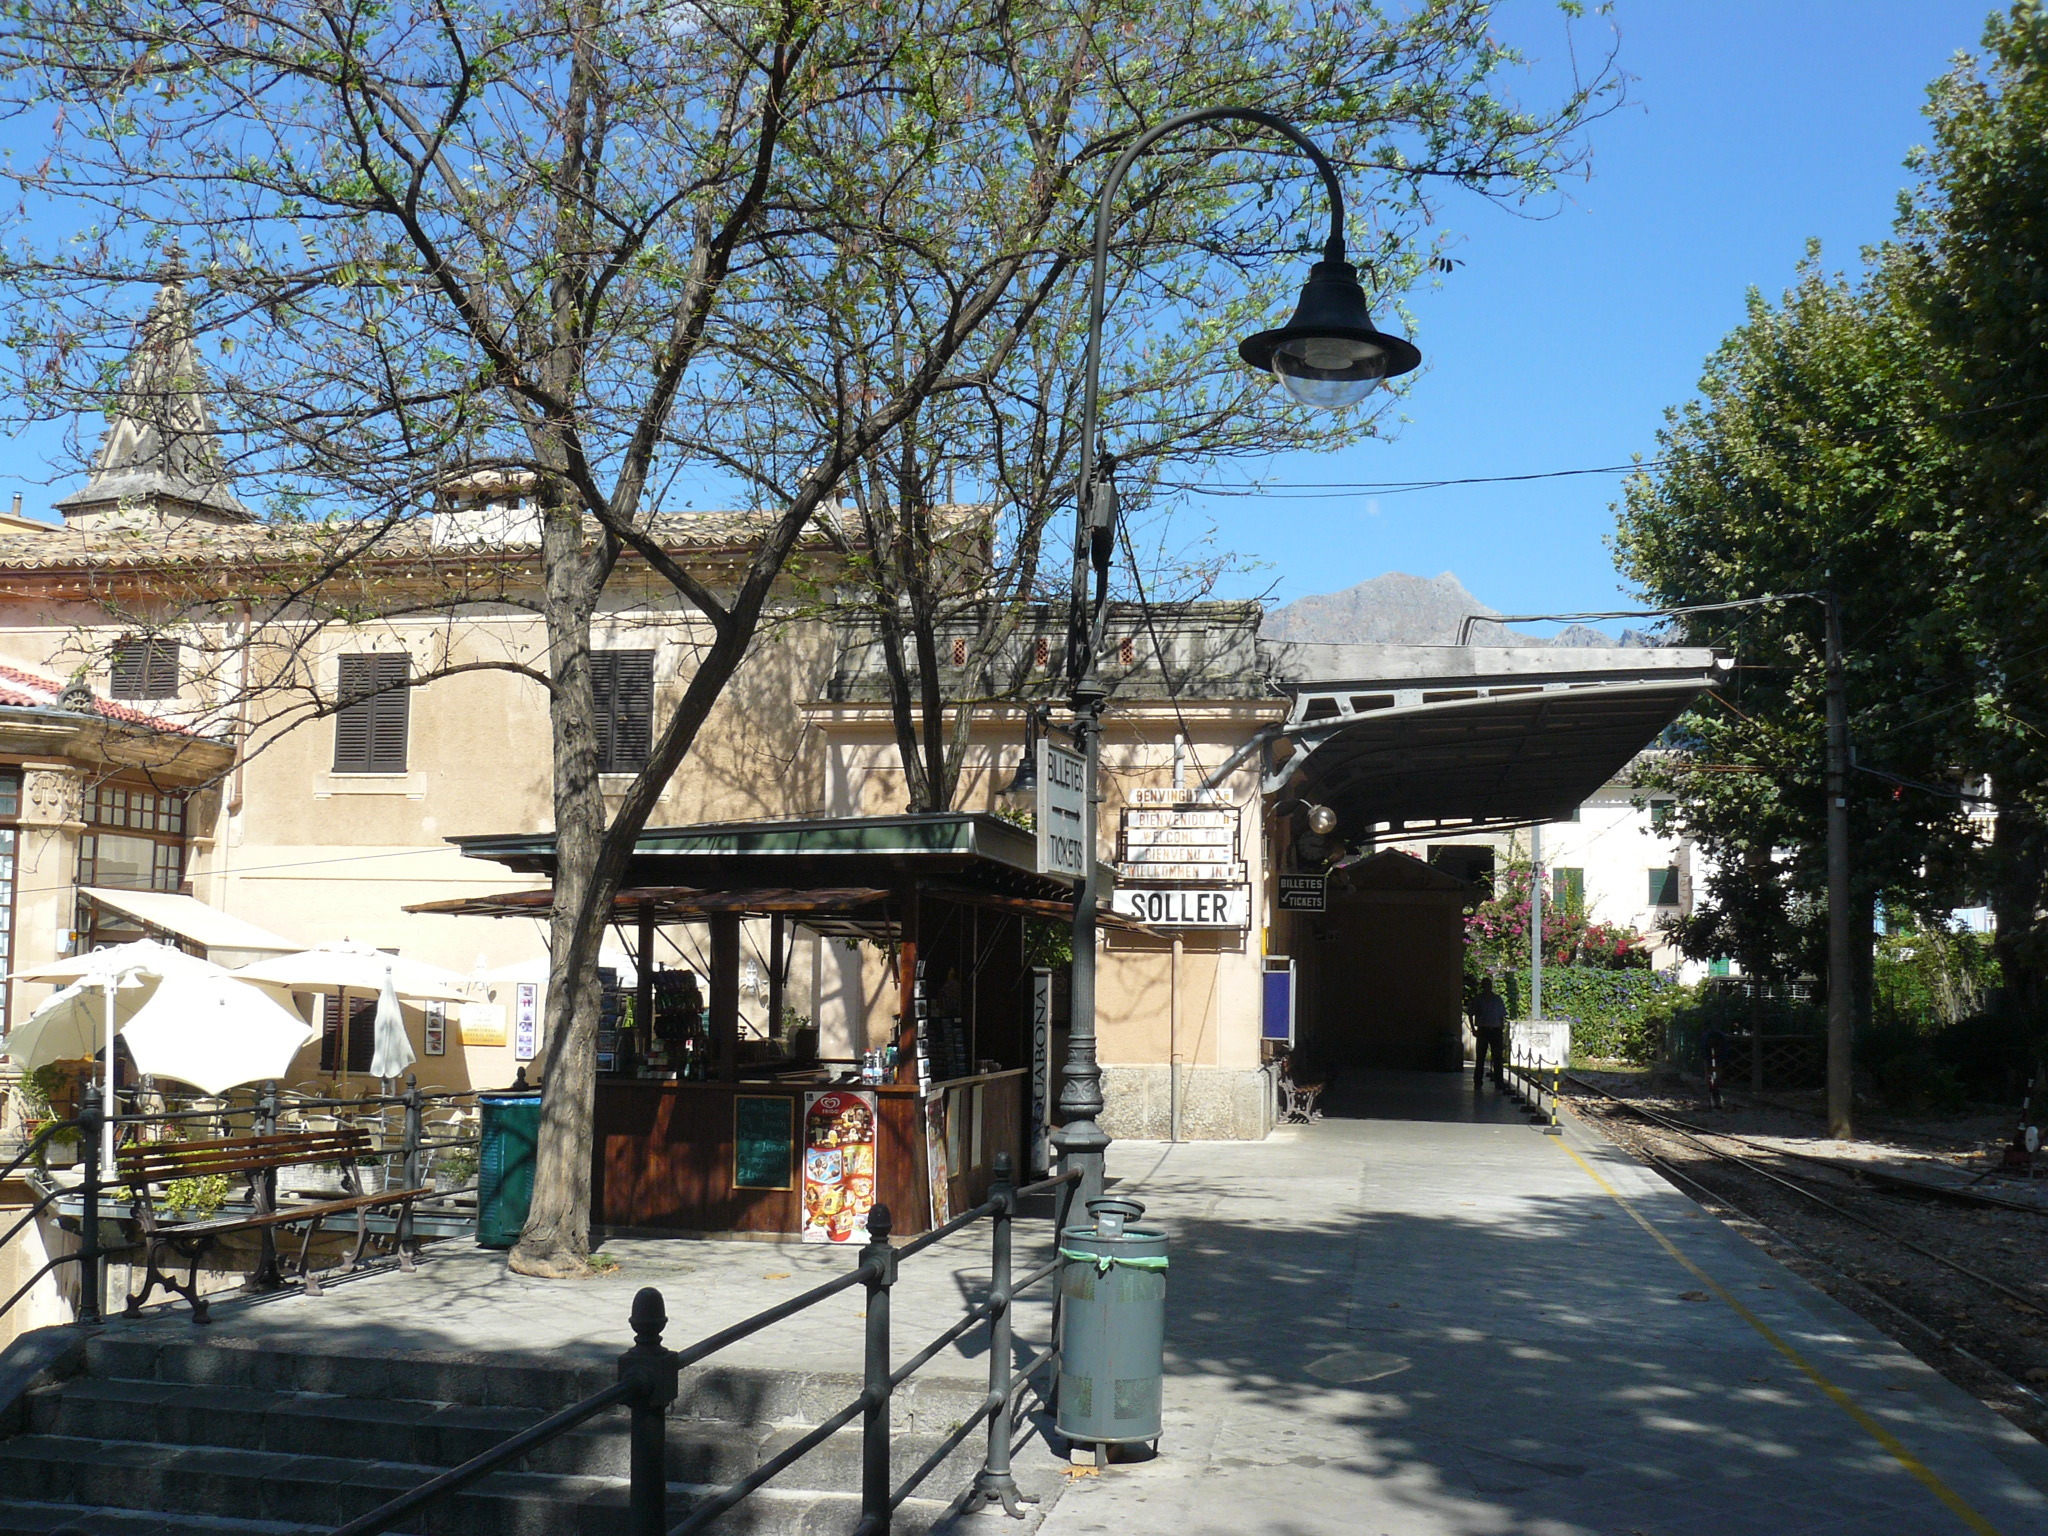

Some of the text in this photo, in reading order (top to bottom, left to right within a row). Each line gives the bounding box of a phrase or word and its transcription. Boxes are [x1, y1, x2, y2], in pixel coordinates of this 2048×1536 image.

[1136, 790, 1200, 803] BENVINGUT
[1140, 813, 1206, 826] BIENVENIDO
[1142, 831, 1218, 844] WELCOME TO
[1050, 834, 1083, 870] TICKETS
[1145, 848, 1201, 860] BIENVENU
[1126, 865, 1223, 878] WILLKOMMEN IN
[1280, 878, 1323, 889] BILLETES
[1131, 892, 1228, 922] SOLLER
[1289, 896, 1322, 907] TICKETS
